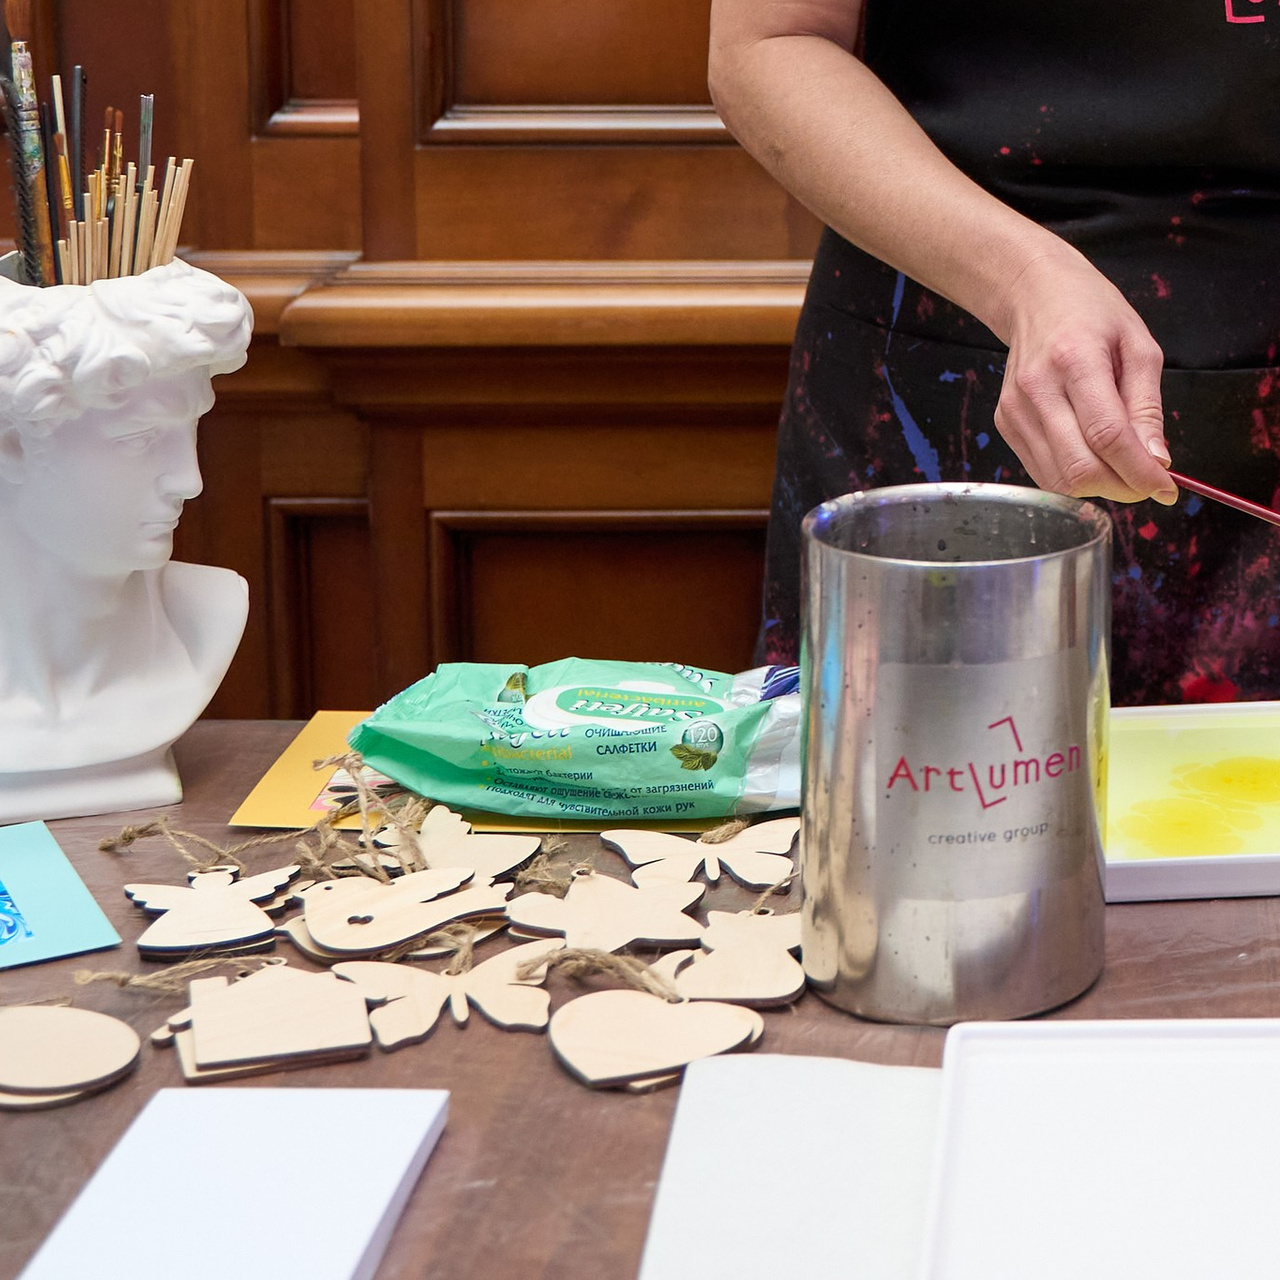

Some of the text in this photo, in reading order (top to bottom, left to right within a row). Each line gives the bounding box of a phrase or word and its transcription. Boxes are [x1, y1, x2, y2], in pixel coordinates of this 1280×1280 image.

[569, 699, 703, 722] Salfeti
[689, 726, 718, 743] 120
[596, 741, 657, 755] САЛФЕТКИ
[545, 769, 593, 781] бактерии
[887, 743, 1082, 809] ArtLumen
[493, 777, 548, 792] Оставляют
[646, 779, 714, 795] загрязнений
[537, 796, 556, 807] для
[558, 802, 639, 817] чувствительной
[643, 805, 672, 815] кожи
[675, 801, 695, 813] рук
[928, 821, 1050, 846] creative group
